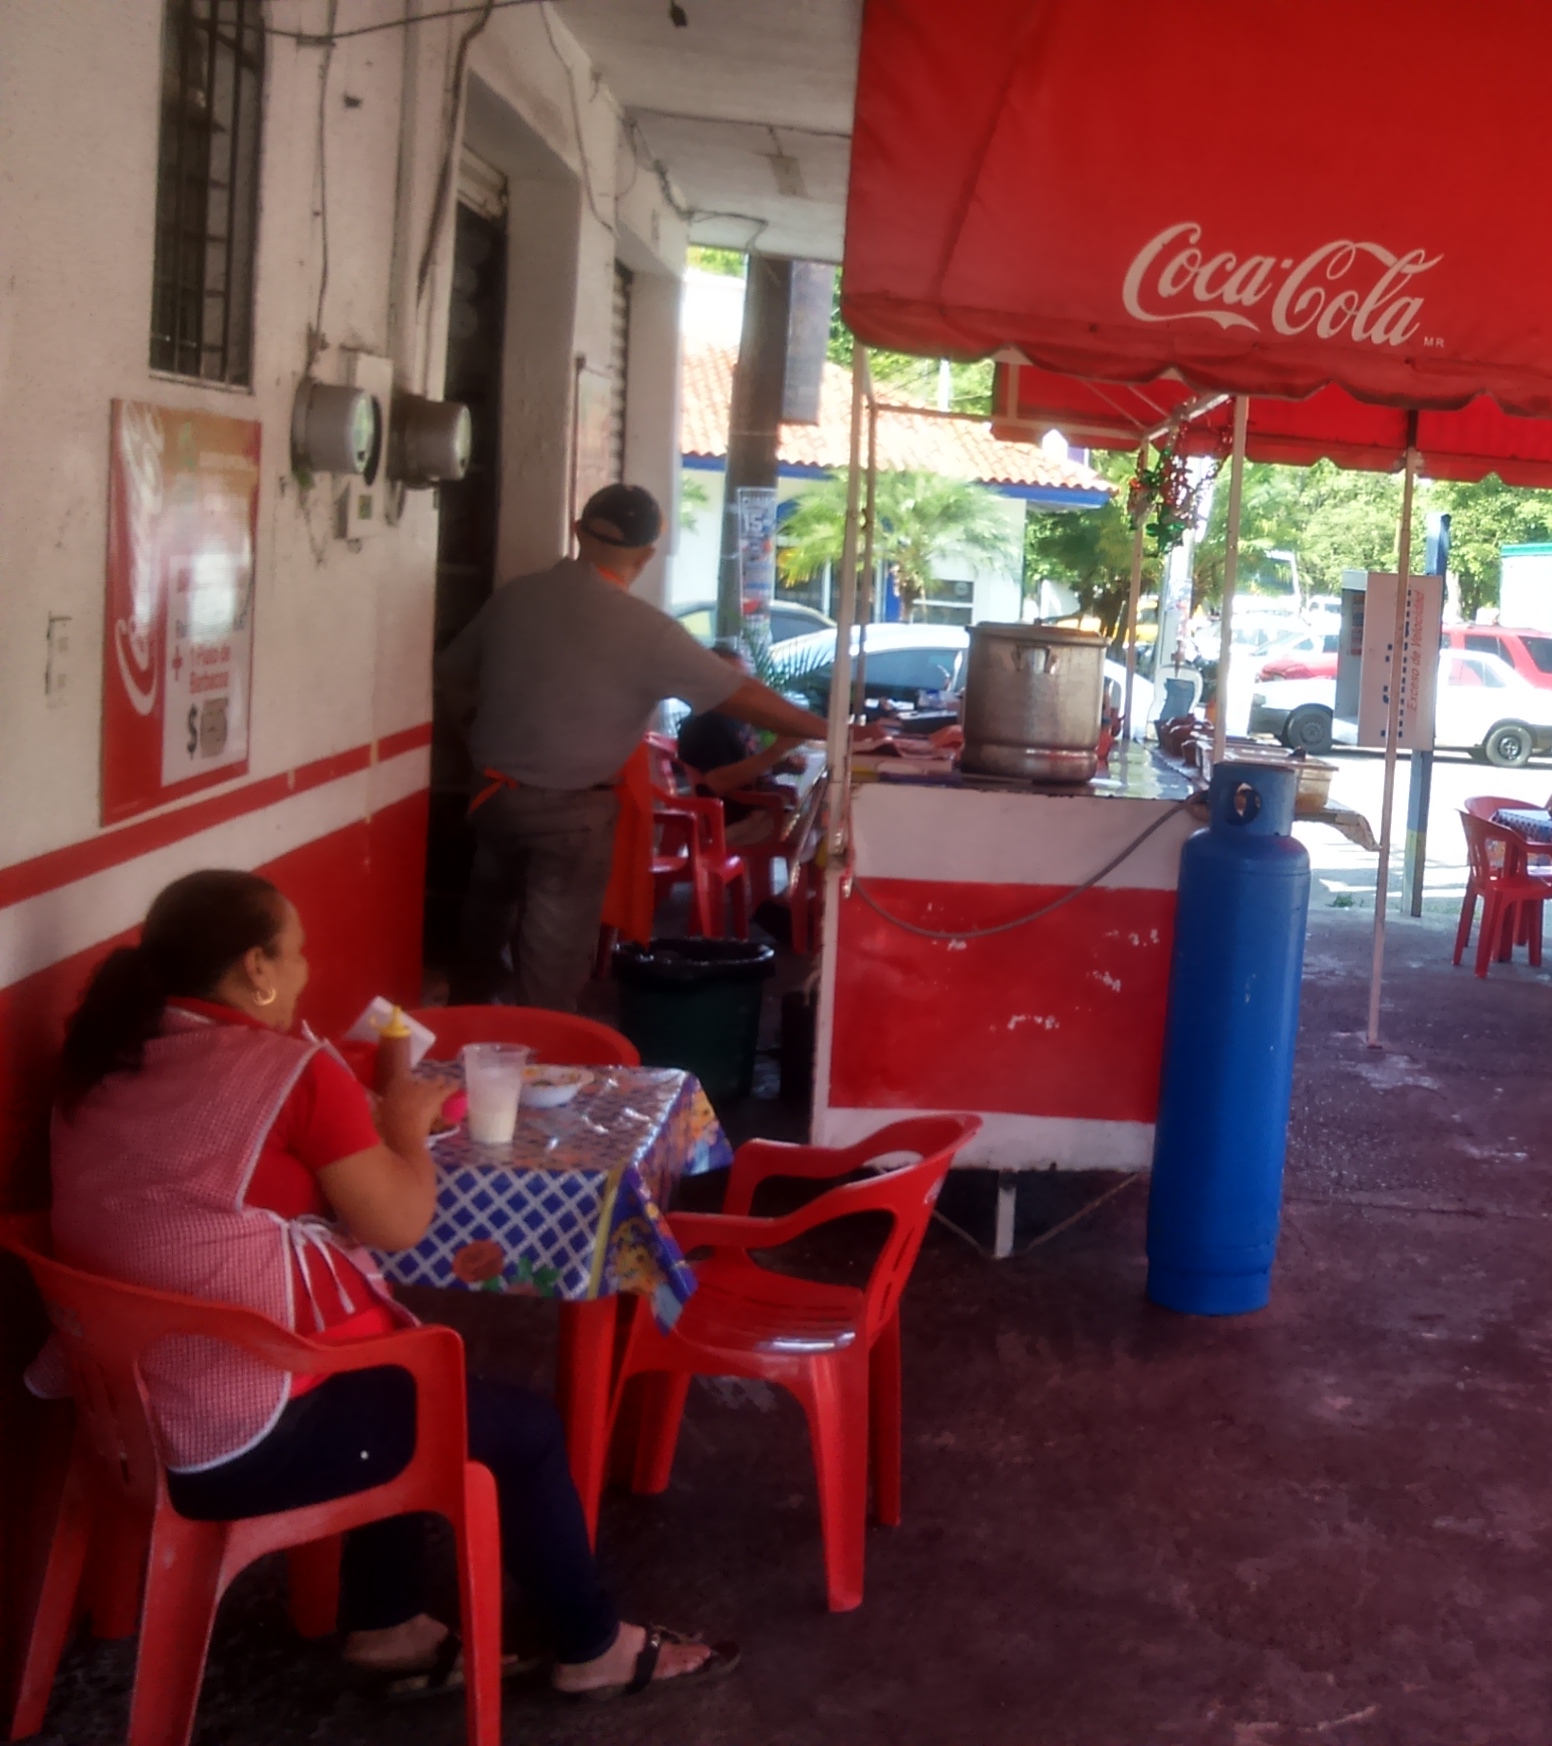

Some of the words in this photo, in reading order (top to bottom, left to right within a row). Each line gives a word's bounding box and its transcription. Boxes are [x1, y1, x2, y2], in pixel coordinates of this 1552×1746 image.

[1122, 222, 1444, 346] Coca-Cola
[1412, 591, 1425, 648] Velocidad
[1410, 650, 1421, 667] de
[1408, 669, 1420, 712] Exceso
